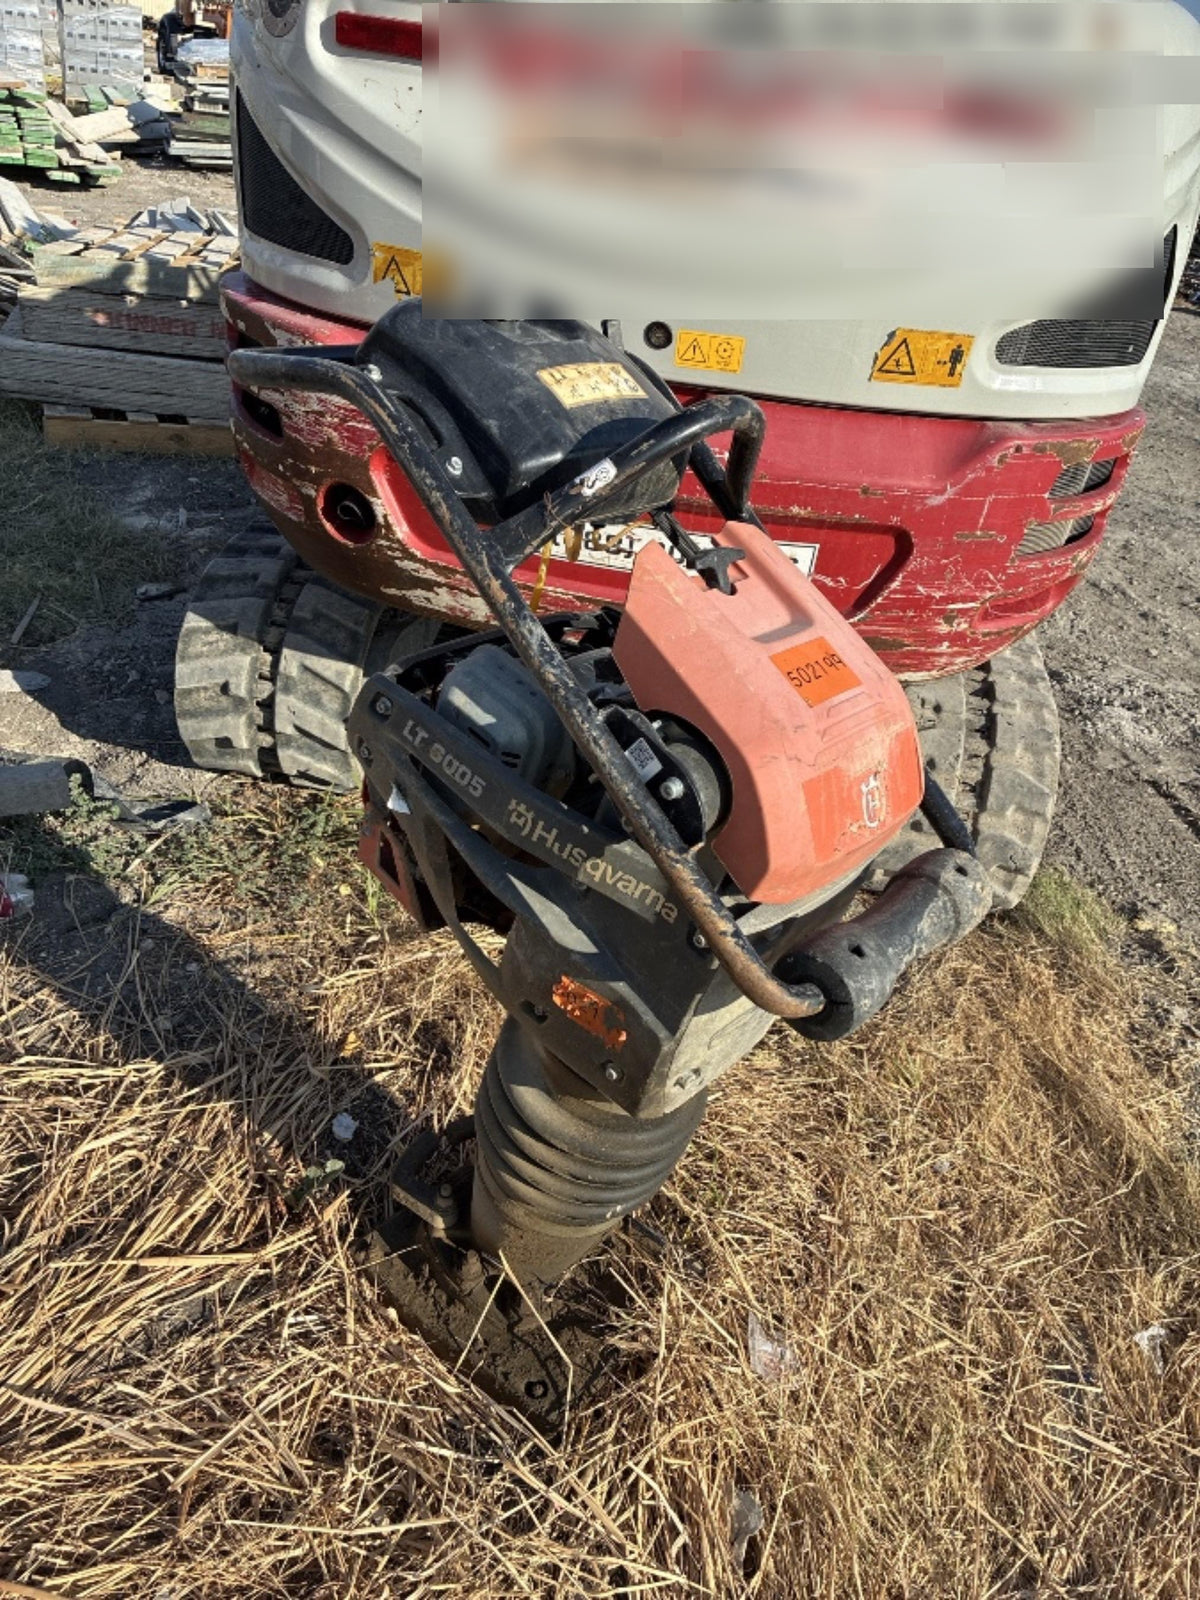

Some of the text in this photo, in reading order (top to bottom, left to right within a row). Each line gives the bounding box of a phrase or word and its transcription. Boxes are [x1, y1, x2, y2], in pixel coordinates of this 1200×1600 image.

[787, 653, 845, 688] 502199
[402, 719, 429, 746] LT
[532, 818, 679, 924] Husqvarna
